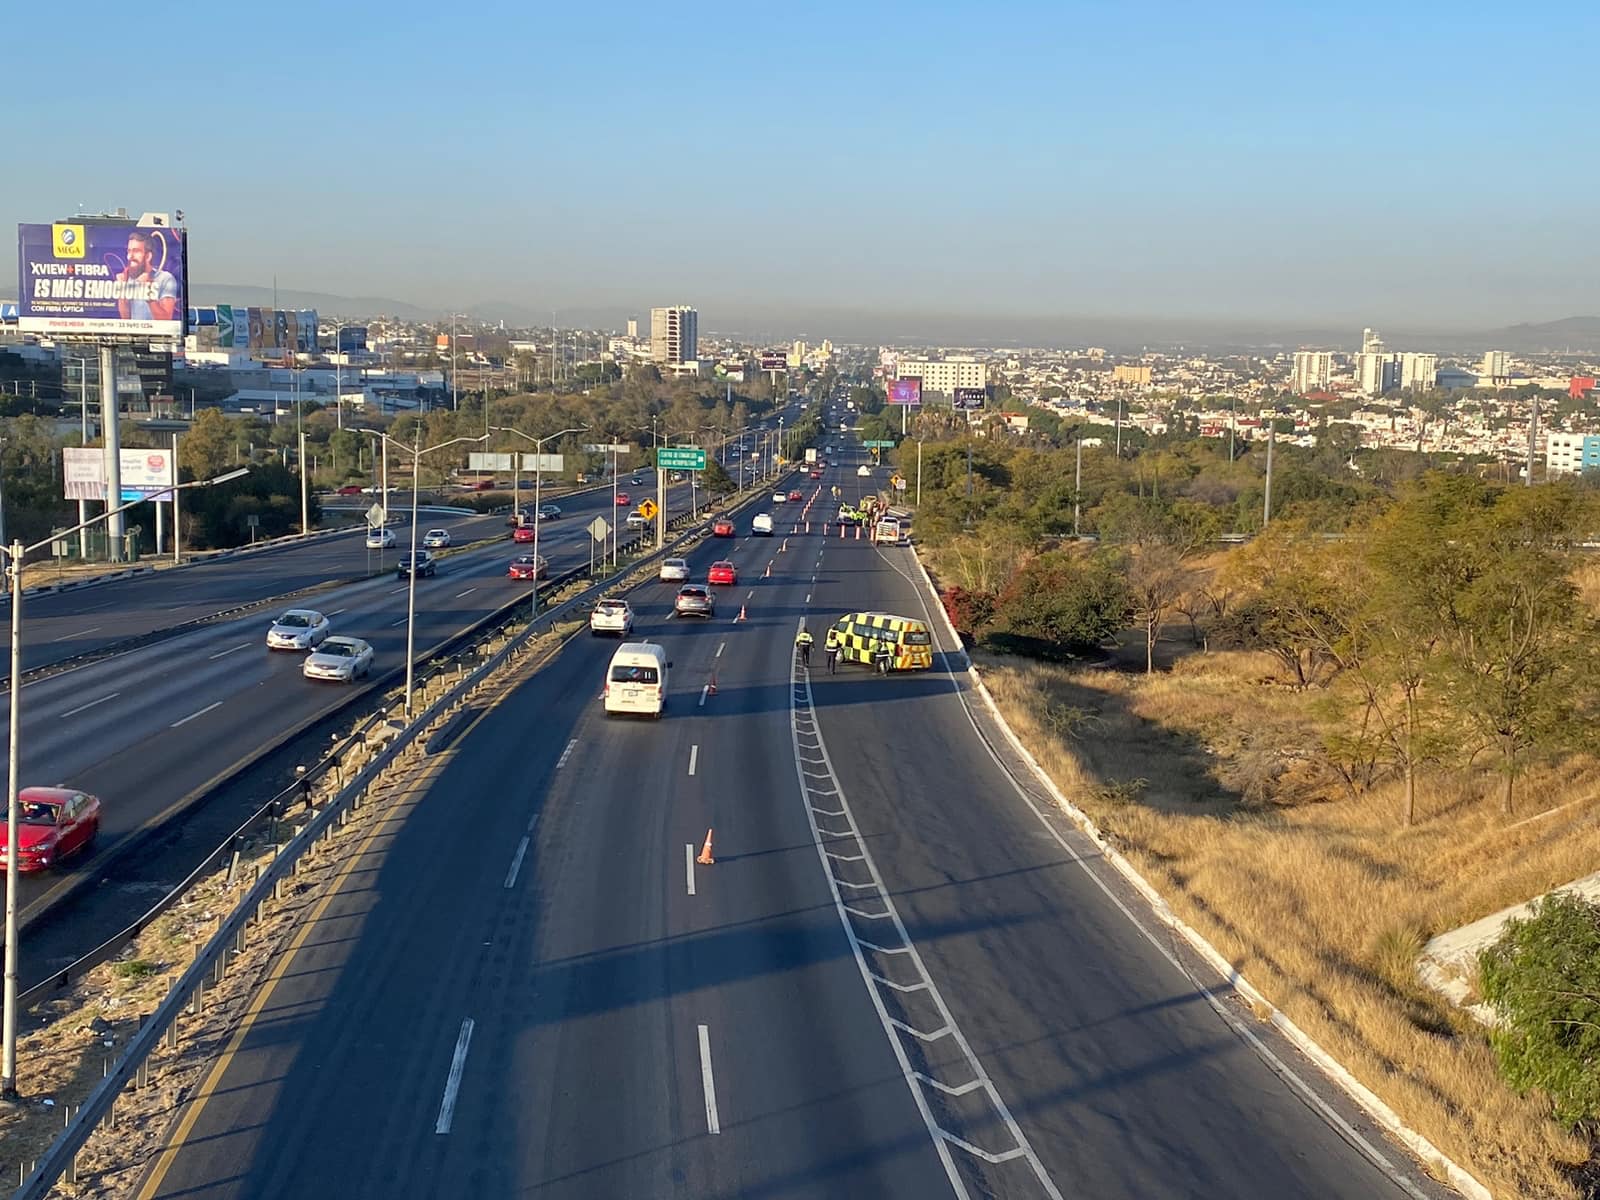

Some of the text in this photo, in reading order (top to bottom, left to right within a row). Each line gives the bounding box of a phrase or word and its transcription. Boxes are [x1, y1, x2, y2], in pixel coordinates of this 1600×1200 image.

[57, 246, 80, 254] MEGA
[34, 276, 159, 300] ES MÁS EMOCIONES
[62, 304, 84, 313] ÓPTICA
